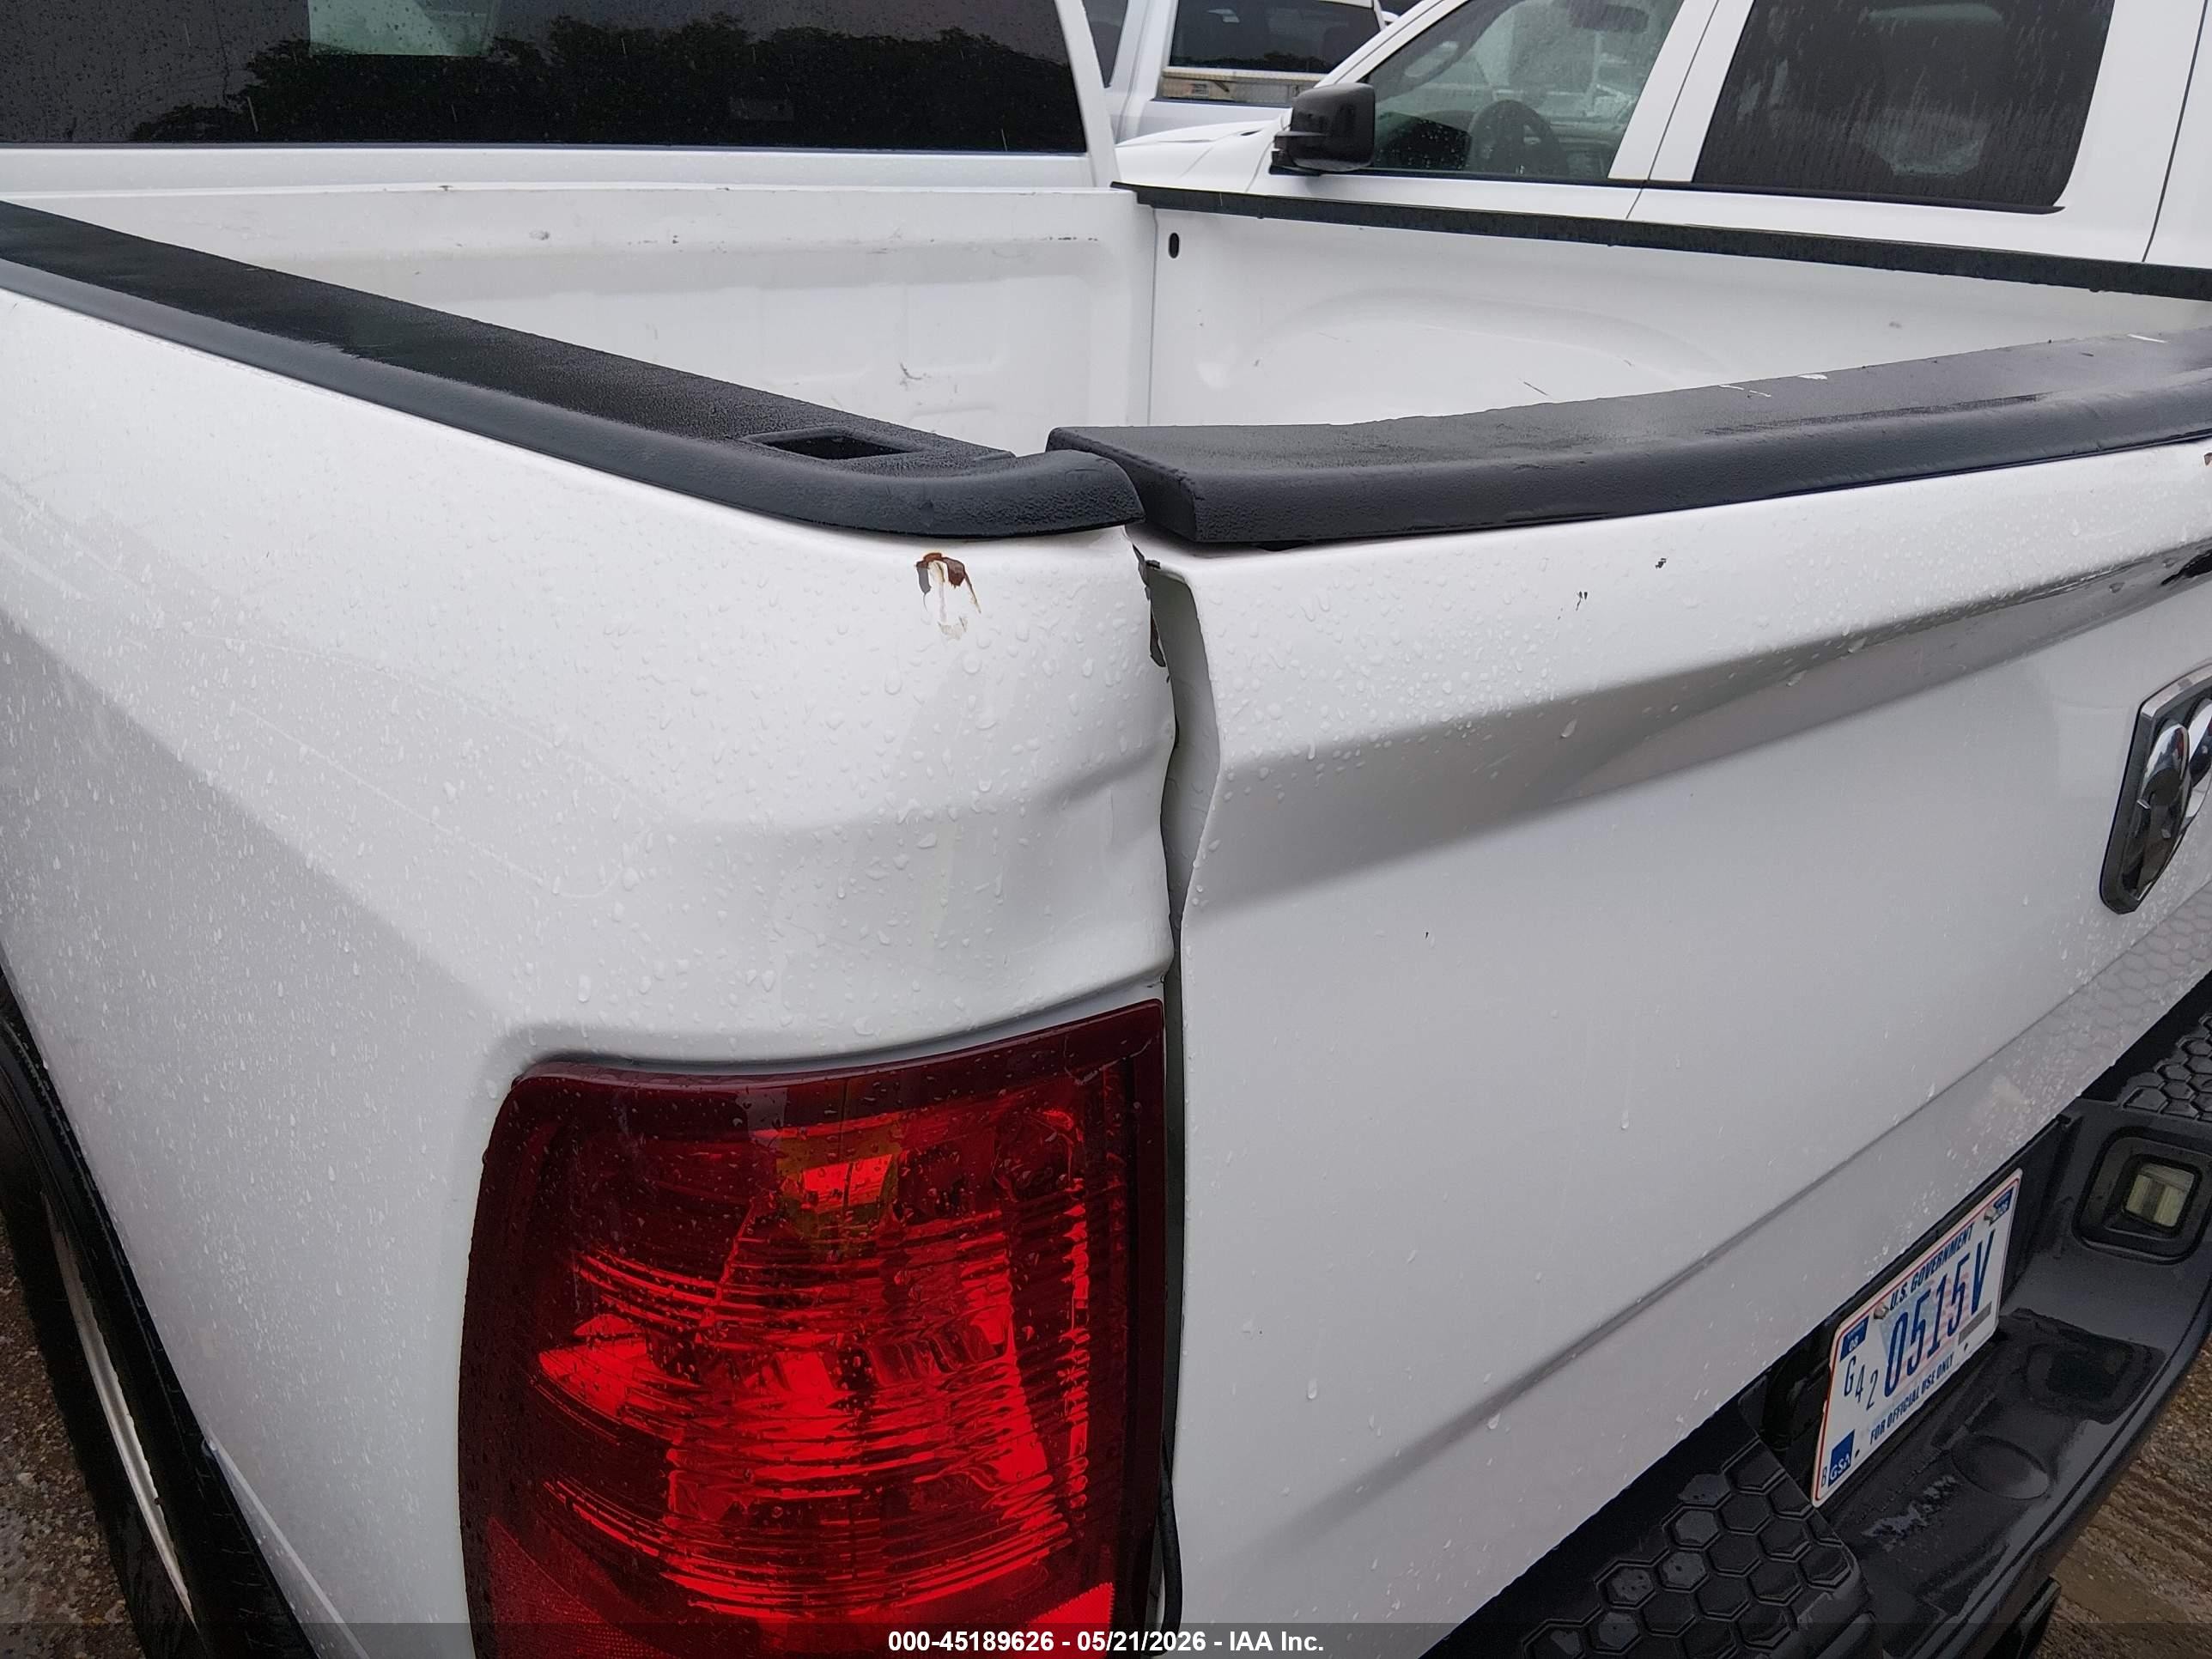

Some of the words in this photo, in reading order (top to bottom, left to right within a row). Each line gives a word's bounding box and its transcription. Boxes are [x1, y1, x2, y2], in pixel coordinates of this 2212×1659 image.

[1890, 1282, 1908, 1310] U.S.
[1911, 1223, 1974, 1293] GOVERNMENT
[1870, 1419, 1886, 1445] FOR
[1887, 1386, 1920, 1429] OFFICIAL
[1921, 1370, 1936, 1395] USE
[1936, 1351, 1955, 1378] ONLY
[1830, 1453, 1850, 1480] GSA
